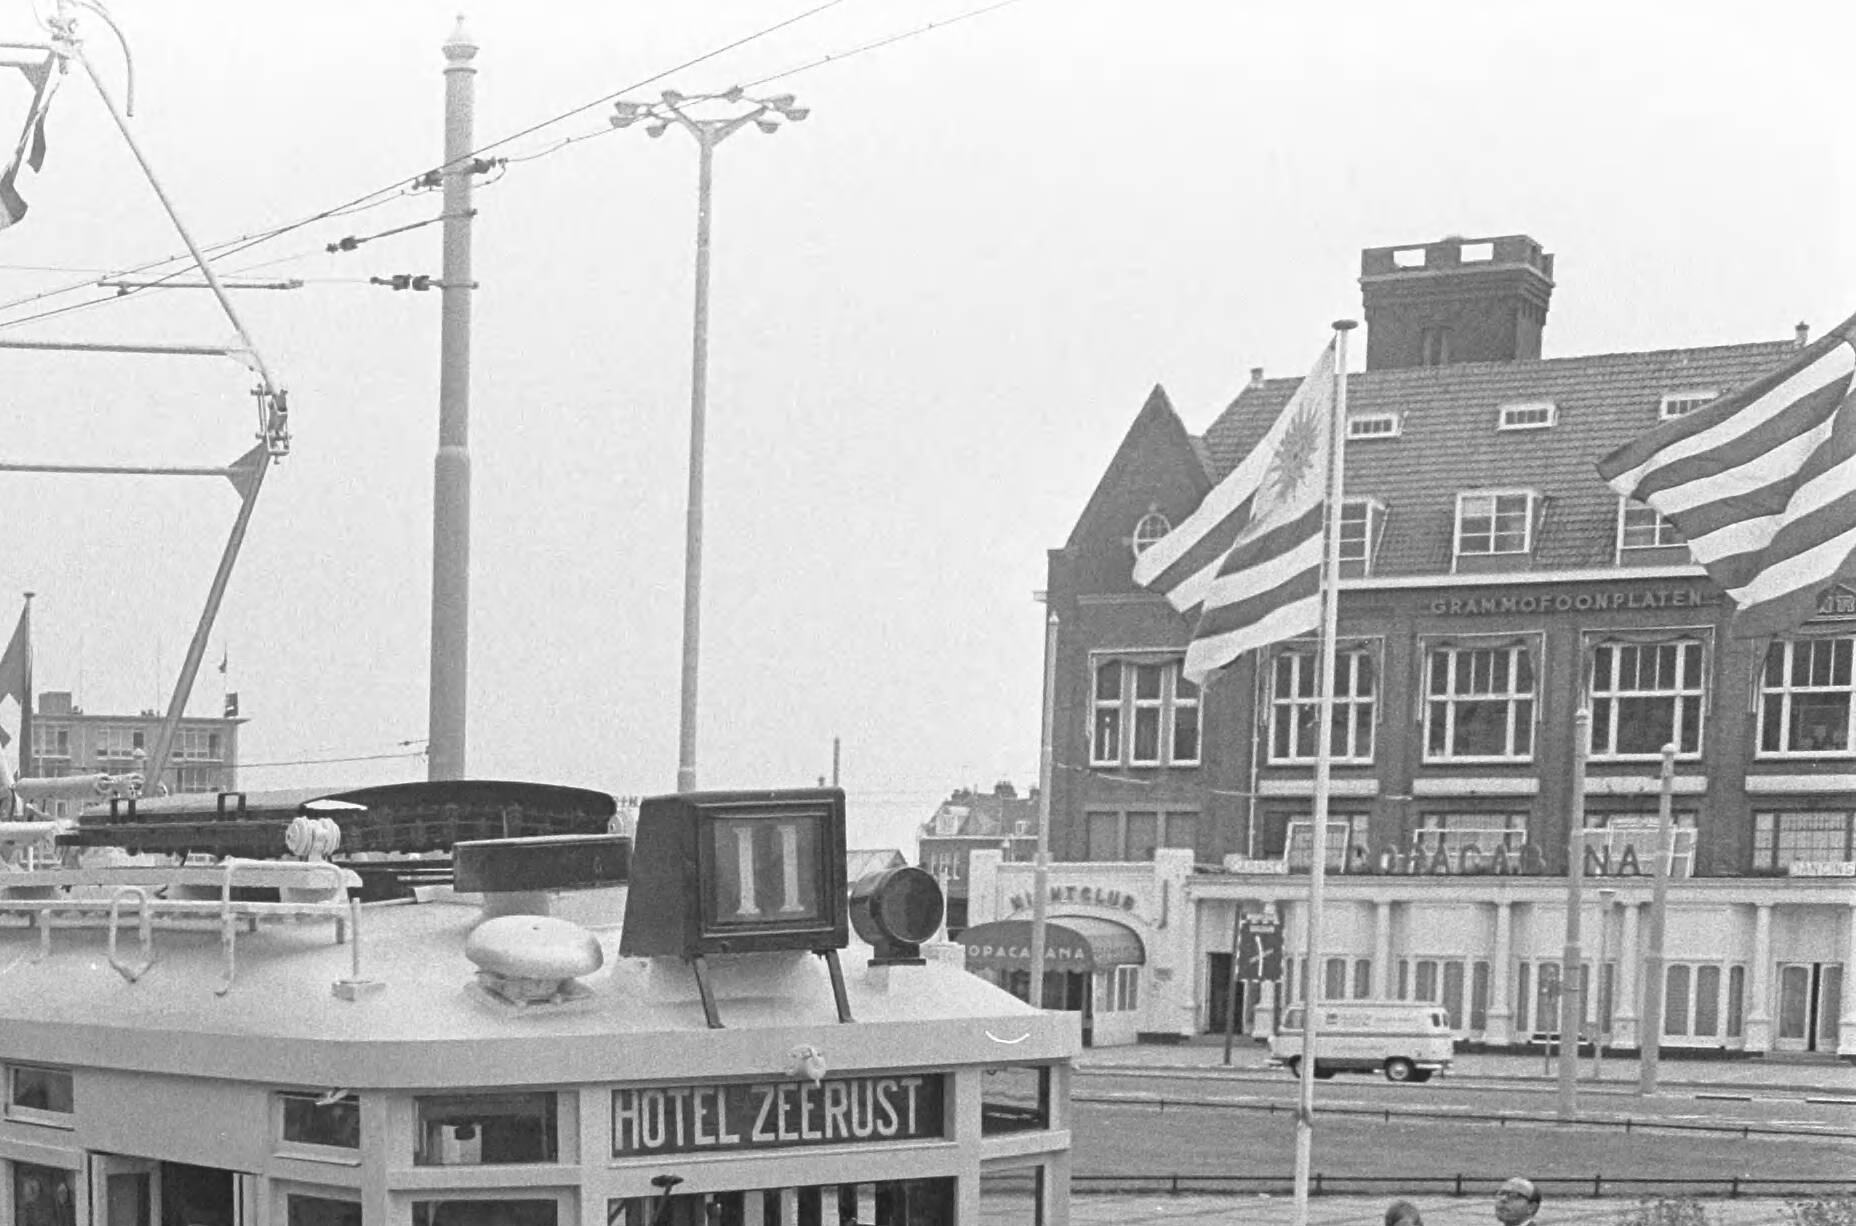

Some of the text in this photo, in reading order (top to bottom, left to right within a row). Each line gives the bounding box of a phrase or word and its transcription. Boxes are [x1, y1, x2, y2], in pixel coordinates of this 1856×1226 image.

[1431, 590, 1702, 615] GRAMMOFOONPLATEN
[732, 825, 806, 916] 11
[1350, 843, 1641, 875] COPACABNA
[1010, 885, 1135, 912] NIHTCLUB
[968, 944, 1085, 960] OPACAANA
[615, 1078, 923, 1151] HOTEL ZEERUST
